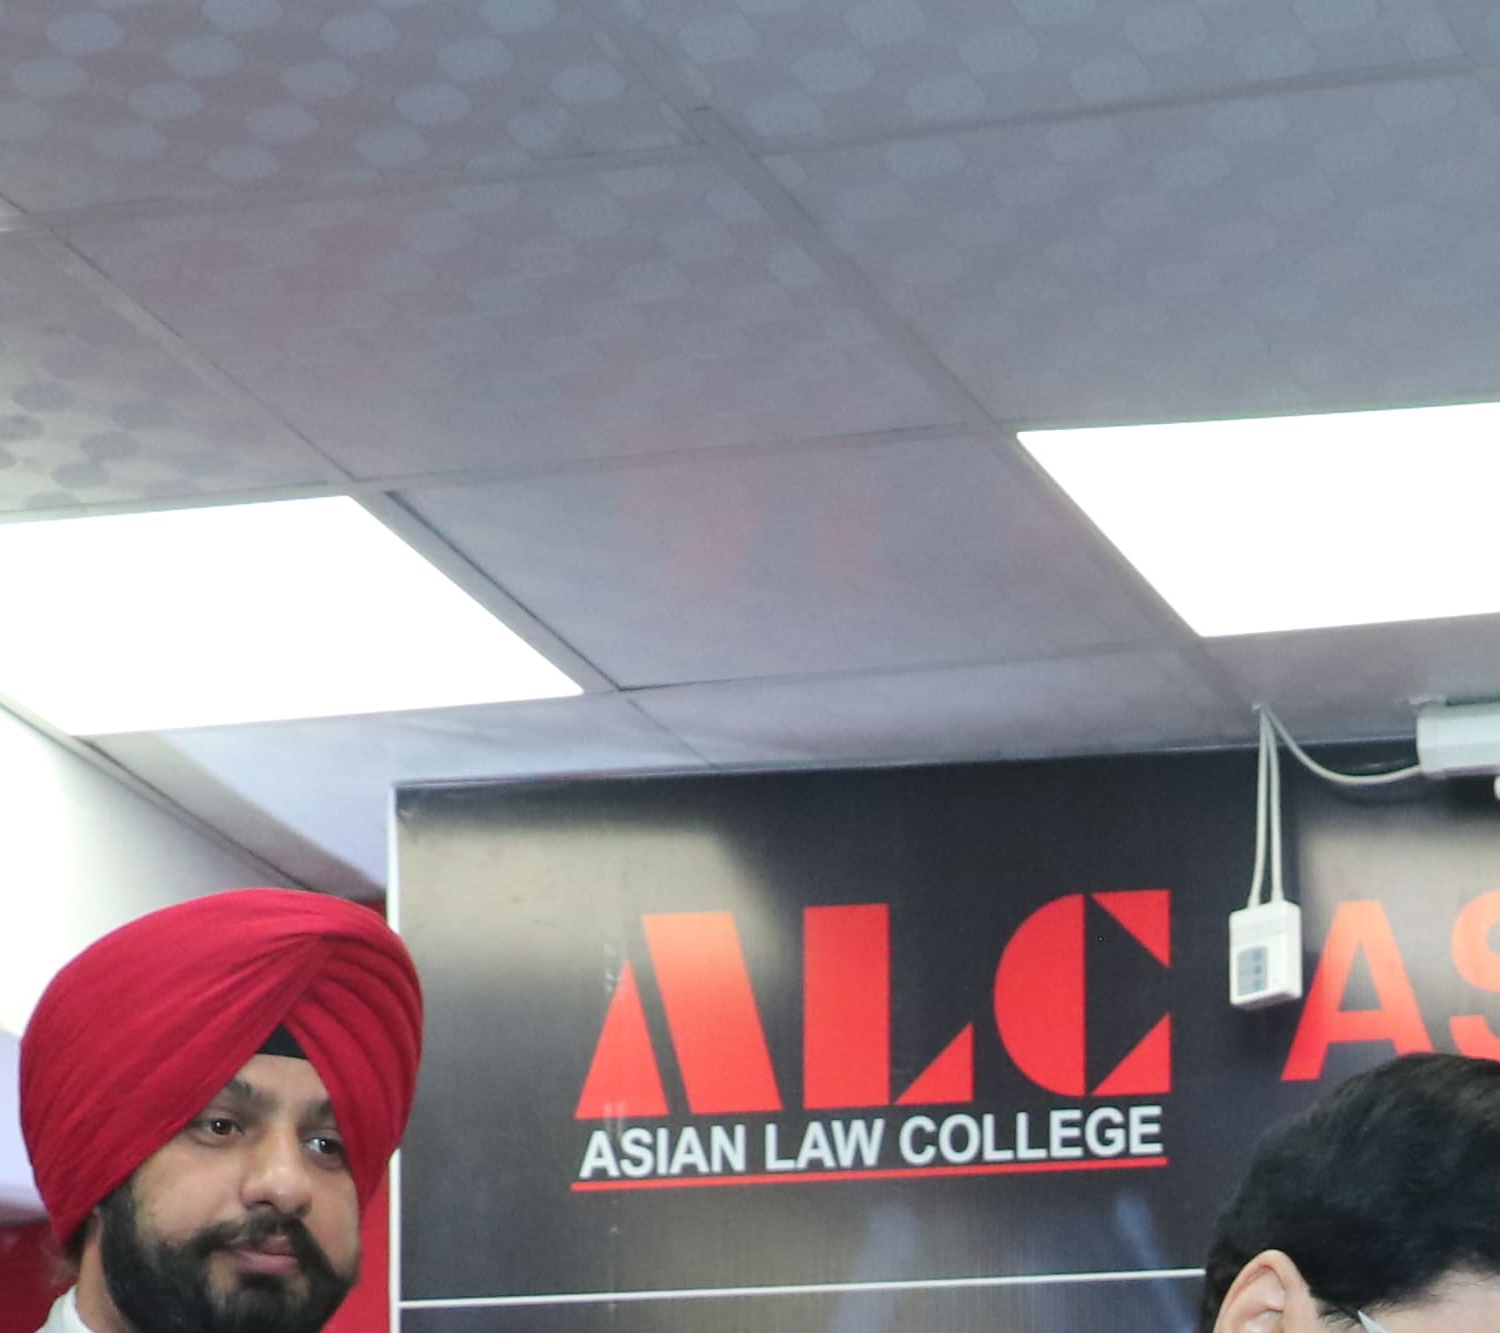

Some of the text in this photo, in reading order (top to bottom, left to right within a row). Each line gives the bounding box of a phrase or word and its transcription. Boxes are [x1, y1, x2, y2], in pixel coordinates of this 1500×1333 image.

[574, 889, 1171, 1120] ALC
[579, 1105, 1163, 1179] ASIAN LAW COLLEGE
